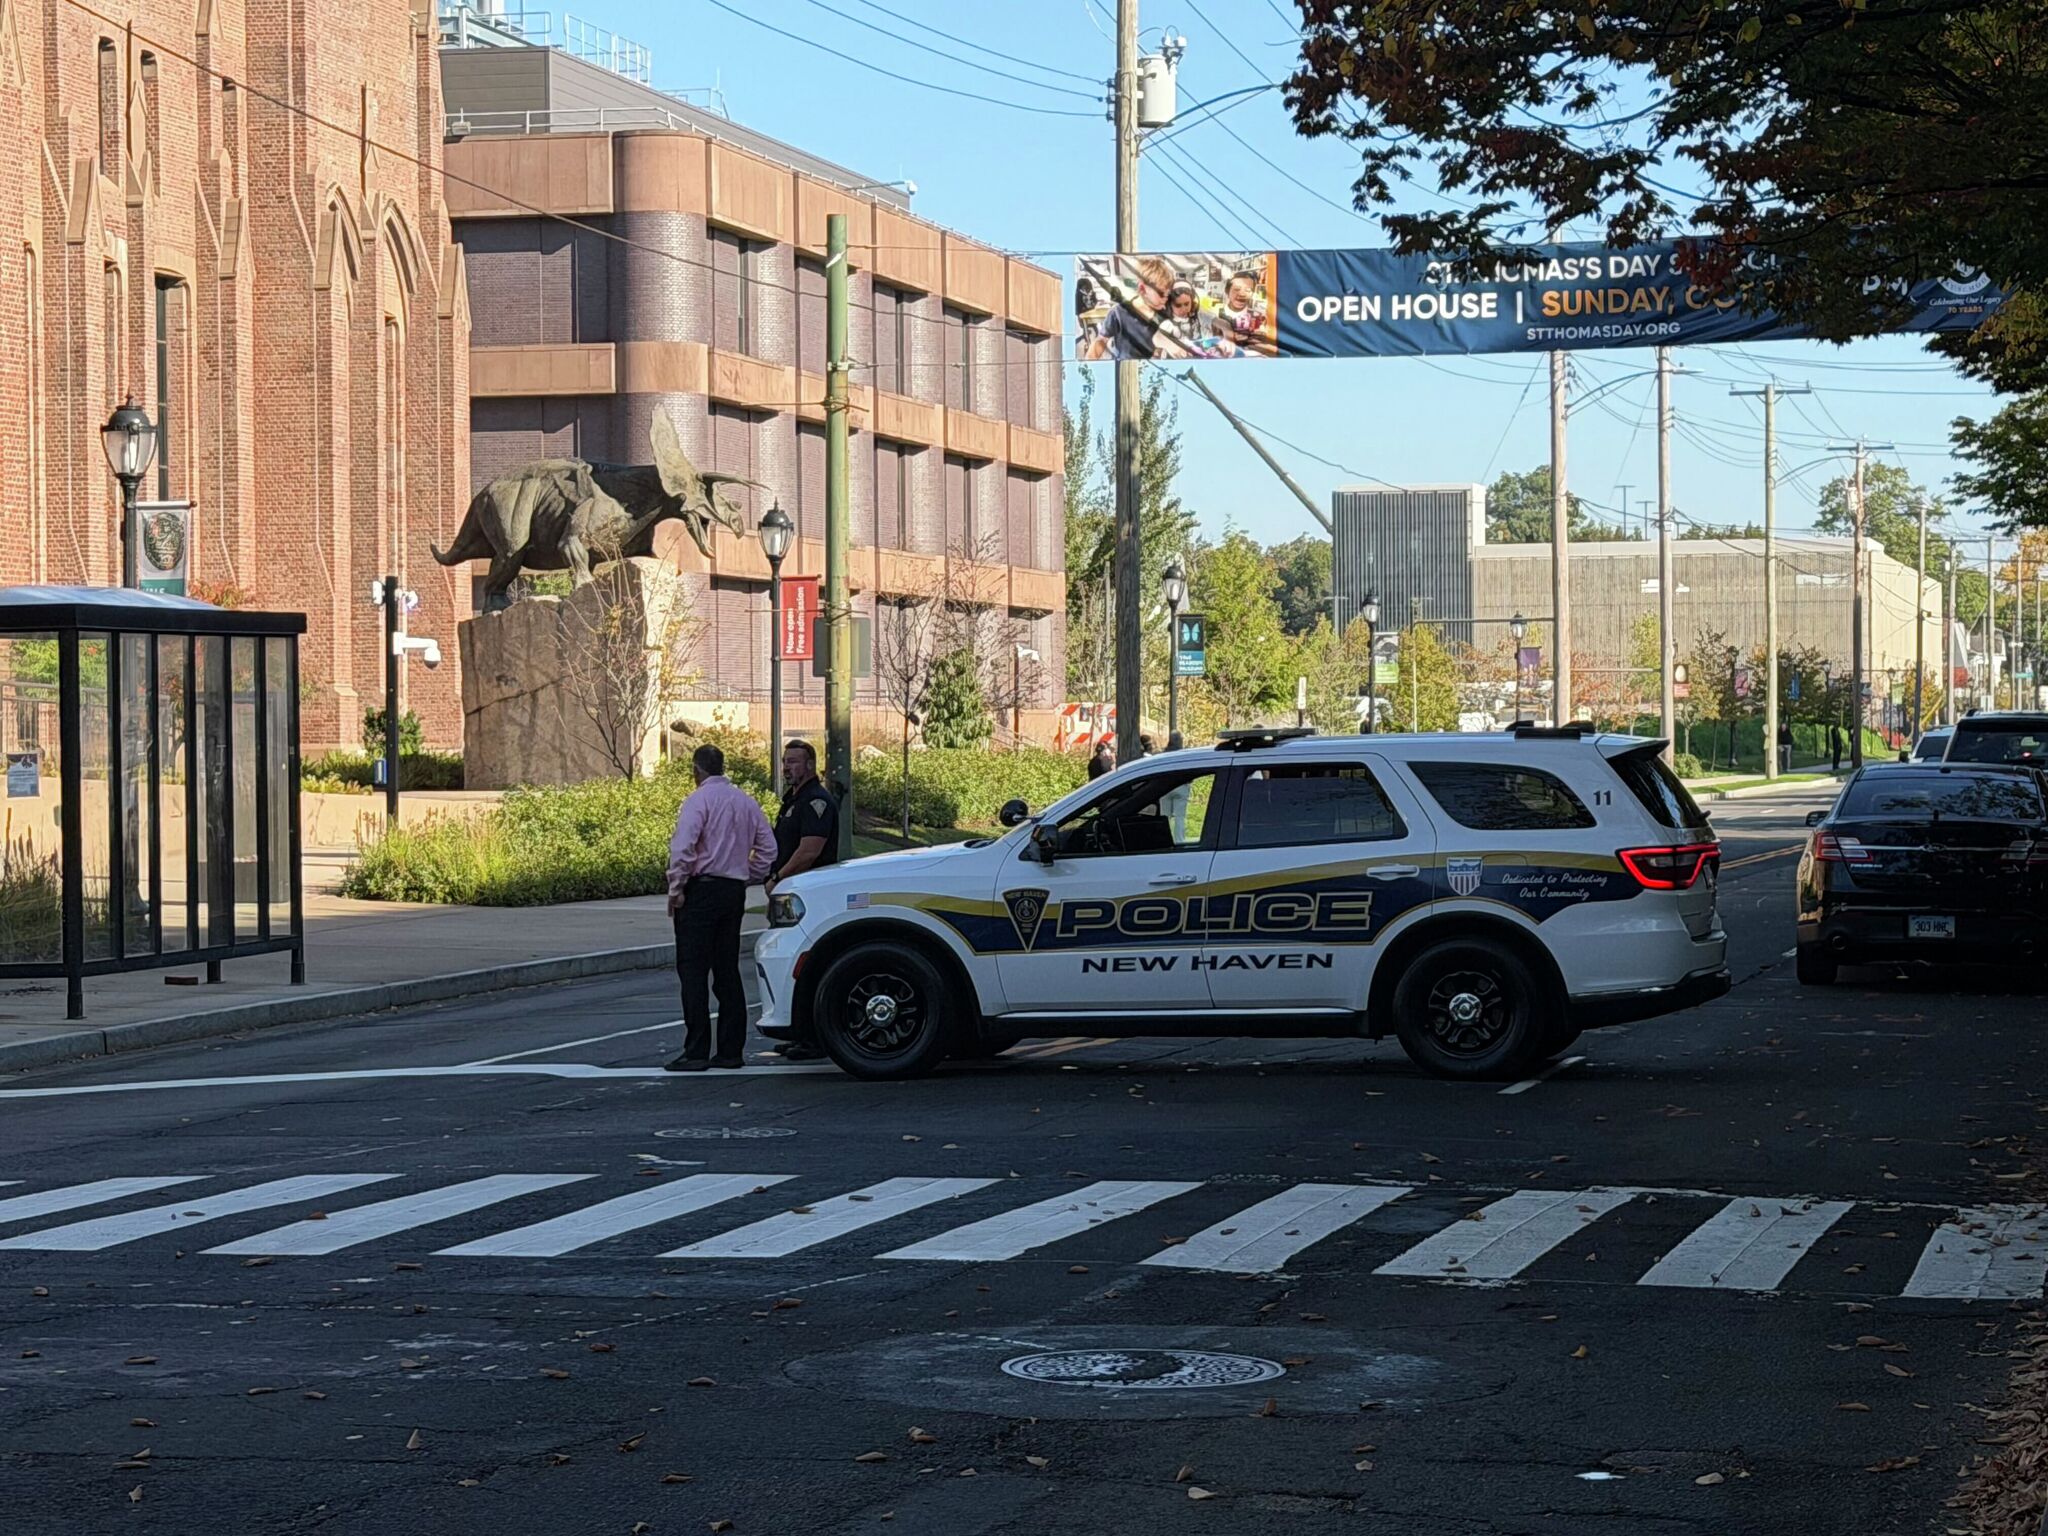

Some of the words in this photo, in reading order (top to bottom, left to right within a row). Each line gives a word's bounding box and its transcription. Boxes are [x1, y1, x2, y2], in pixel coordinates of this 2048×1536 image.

[1609, 254, 1662, 279] DAY
[1297, 295, 1381, 323] OPEN
[1391, 291, 1498, 321] HOUSE
[1541, 286, 1675, 316] SUNDAY,
[1527, 321, 1681, 341] STTHOMASDAY.ORG
[1593, 790, 1612, 806] 11
[1547, 875, 1557, 883] to
[1056, 891, 1373, 938] POLICE
[1081, 955, 1178, 973] NEW
[1191, 953, 1333, 971] HAVEN
